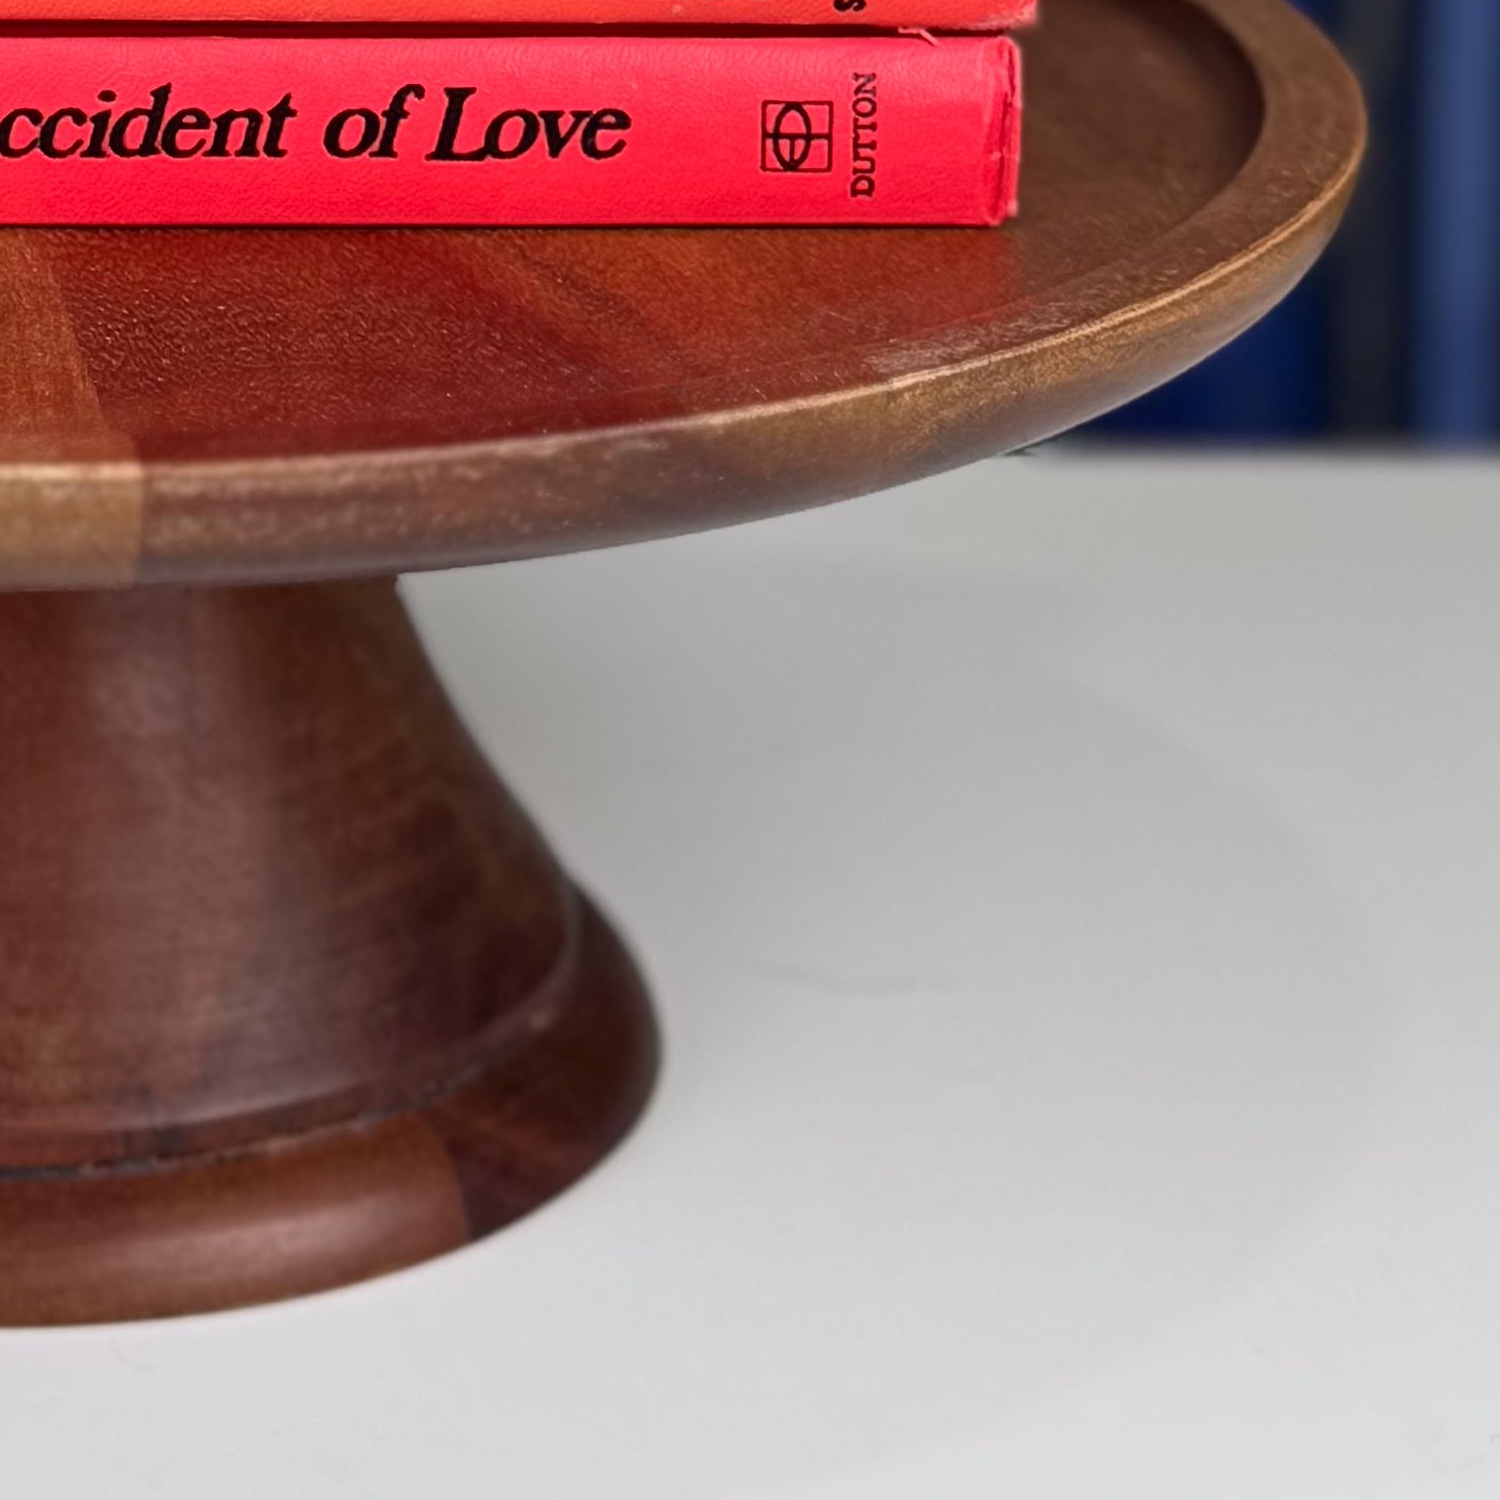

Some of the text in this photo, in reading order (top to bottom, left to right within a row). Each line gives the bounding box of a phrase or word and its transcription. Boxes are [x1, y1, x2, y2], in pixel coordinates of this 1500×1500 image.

[323, 84, 426, 160] of
[424, 84, 632, 163] Love
[849, 72, 878, 199] DUTTON
